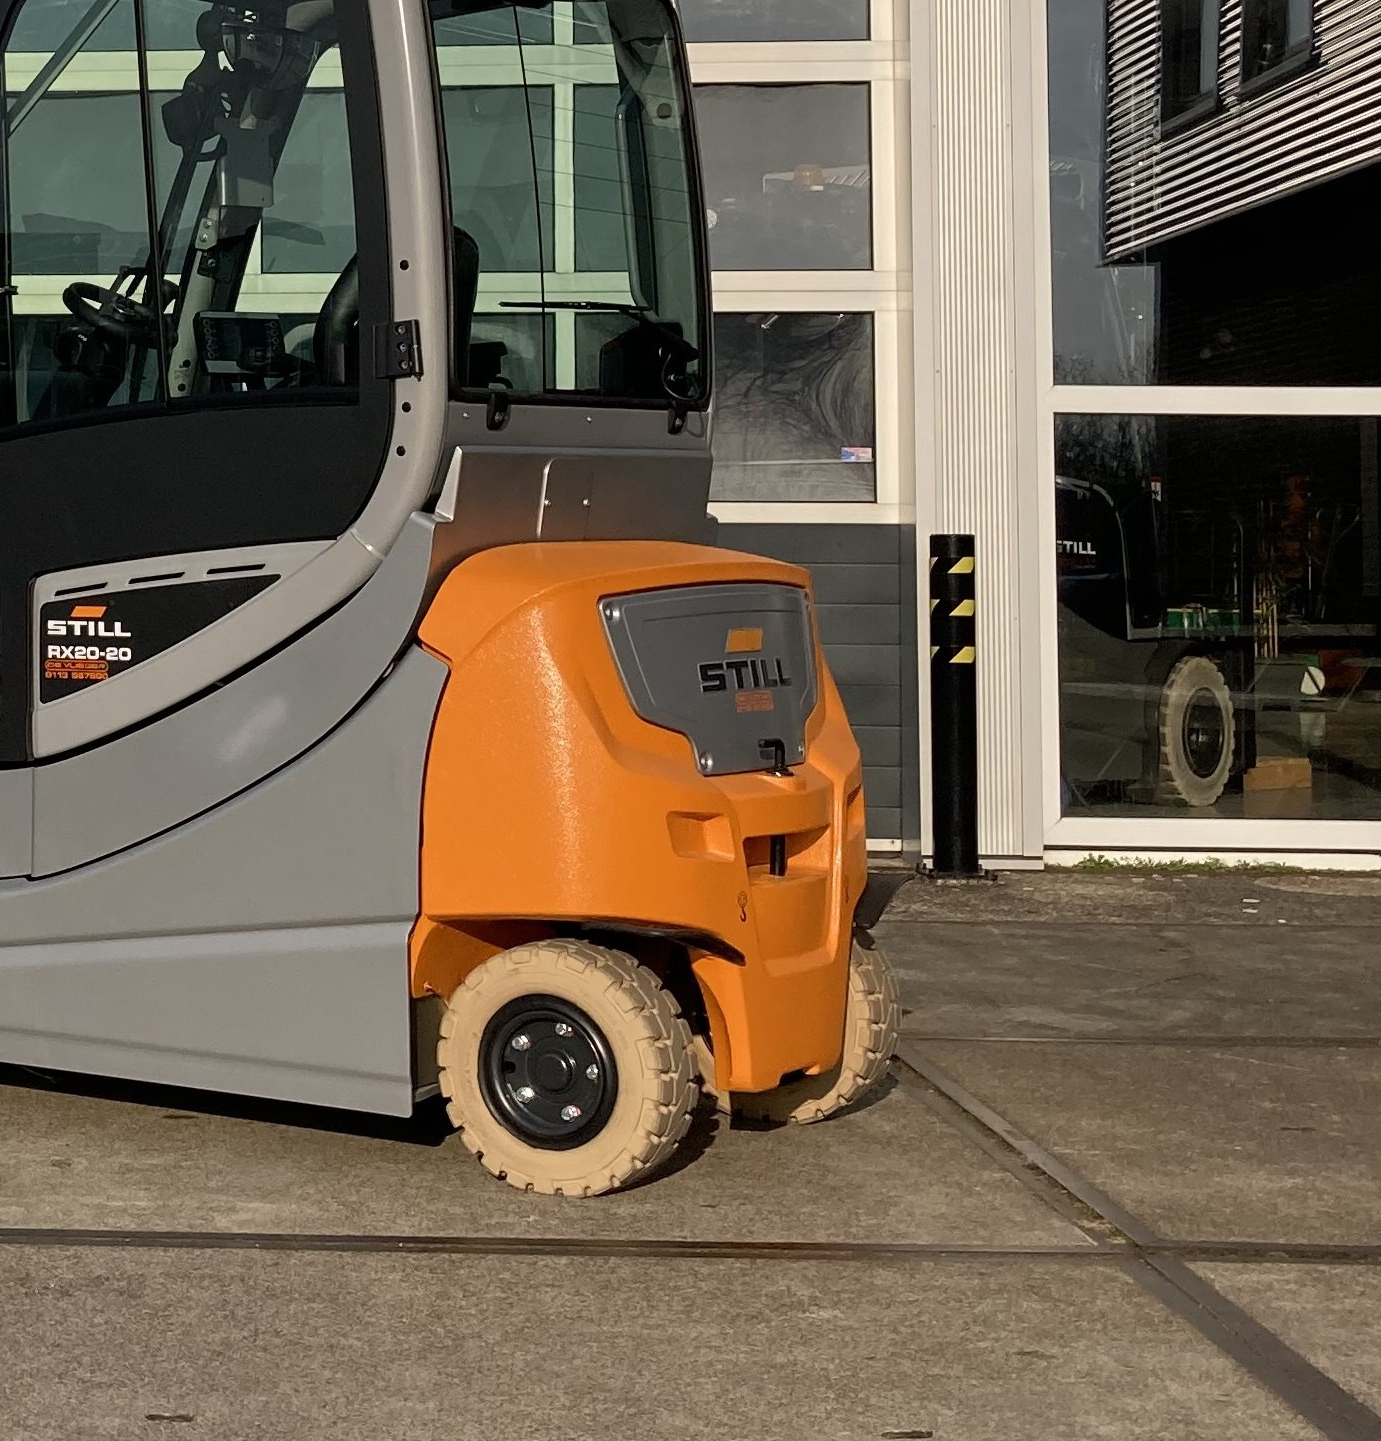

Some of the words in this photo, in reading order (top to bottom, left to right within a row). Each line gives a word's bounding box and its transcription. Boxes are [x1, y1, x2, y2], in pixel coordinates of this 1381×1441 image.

[47, 620, 131, 637] STILL
[47, 645, 131, 661] RX20-20
[698, 658, 792, 693] STILL
